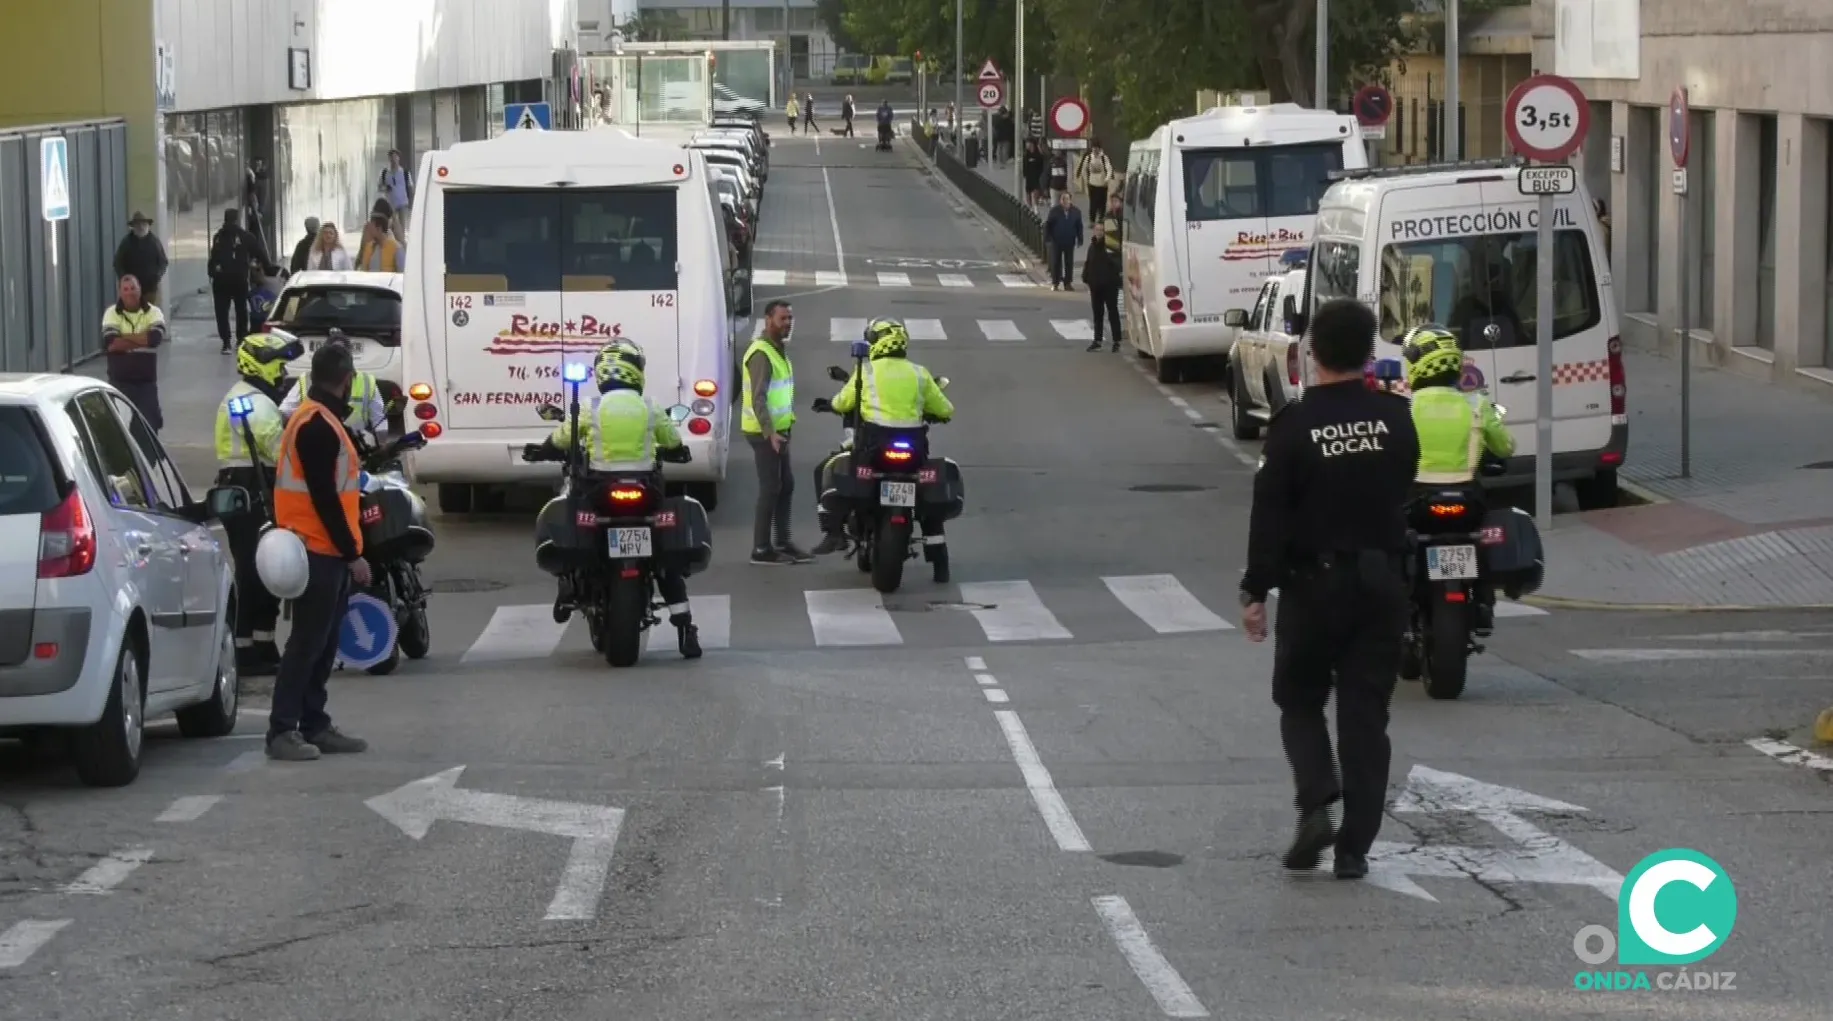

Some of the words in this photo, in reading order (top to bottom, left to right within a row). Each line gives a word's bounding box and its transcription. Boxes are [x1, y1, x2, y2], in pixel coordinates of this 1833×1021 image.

[983, 90, 996, 98] 20
[1521, 105, 1571, 131] 3,5t
[1526, 171, 1568, 179] EXCEPTO
[1533, 180, 1560, 192] BUS
[1391, 208, 1521, 239] PROTECCIÓN
[451, 295, 472, 309] 142
[651, 293, 673, 307] 142
[511, 314, 560, 336] Rico
[581, 314, 621, 336] Bus
[454, 392, 481, 404] SAN
[486, 392, 562, 404] FERNANDO
[1310, 420, 1389, 443] POLICIA
[1321, 437, 1384, 457] LOCAL
[619, 530, 648, 542] 2754
[620, 544, 641, 555] MPV
